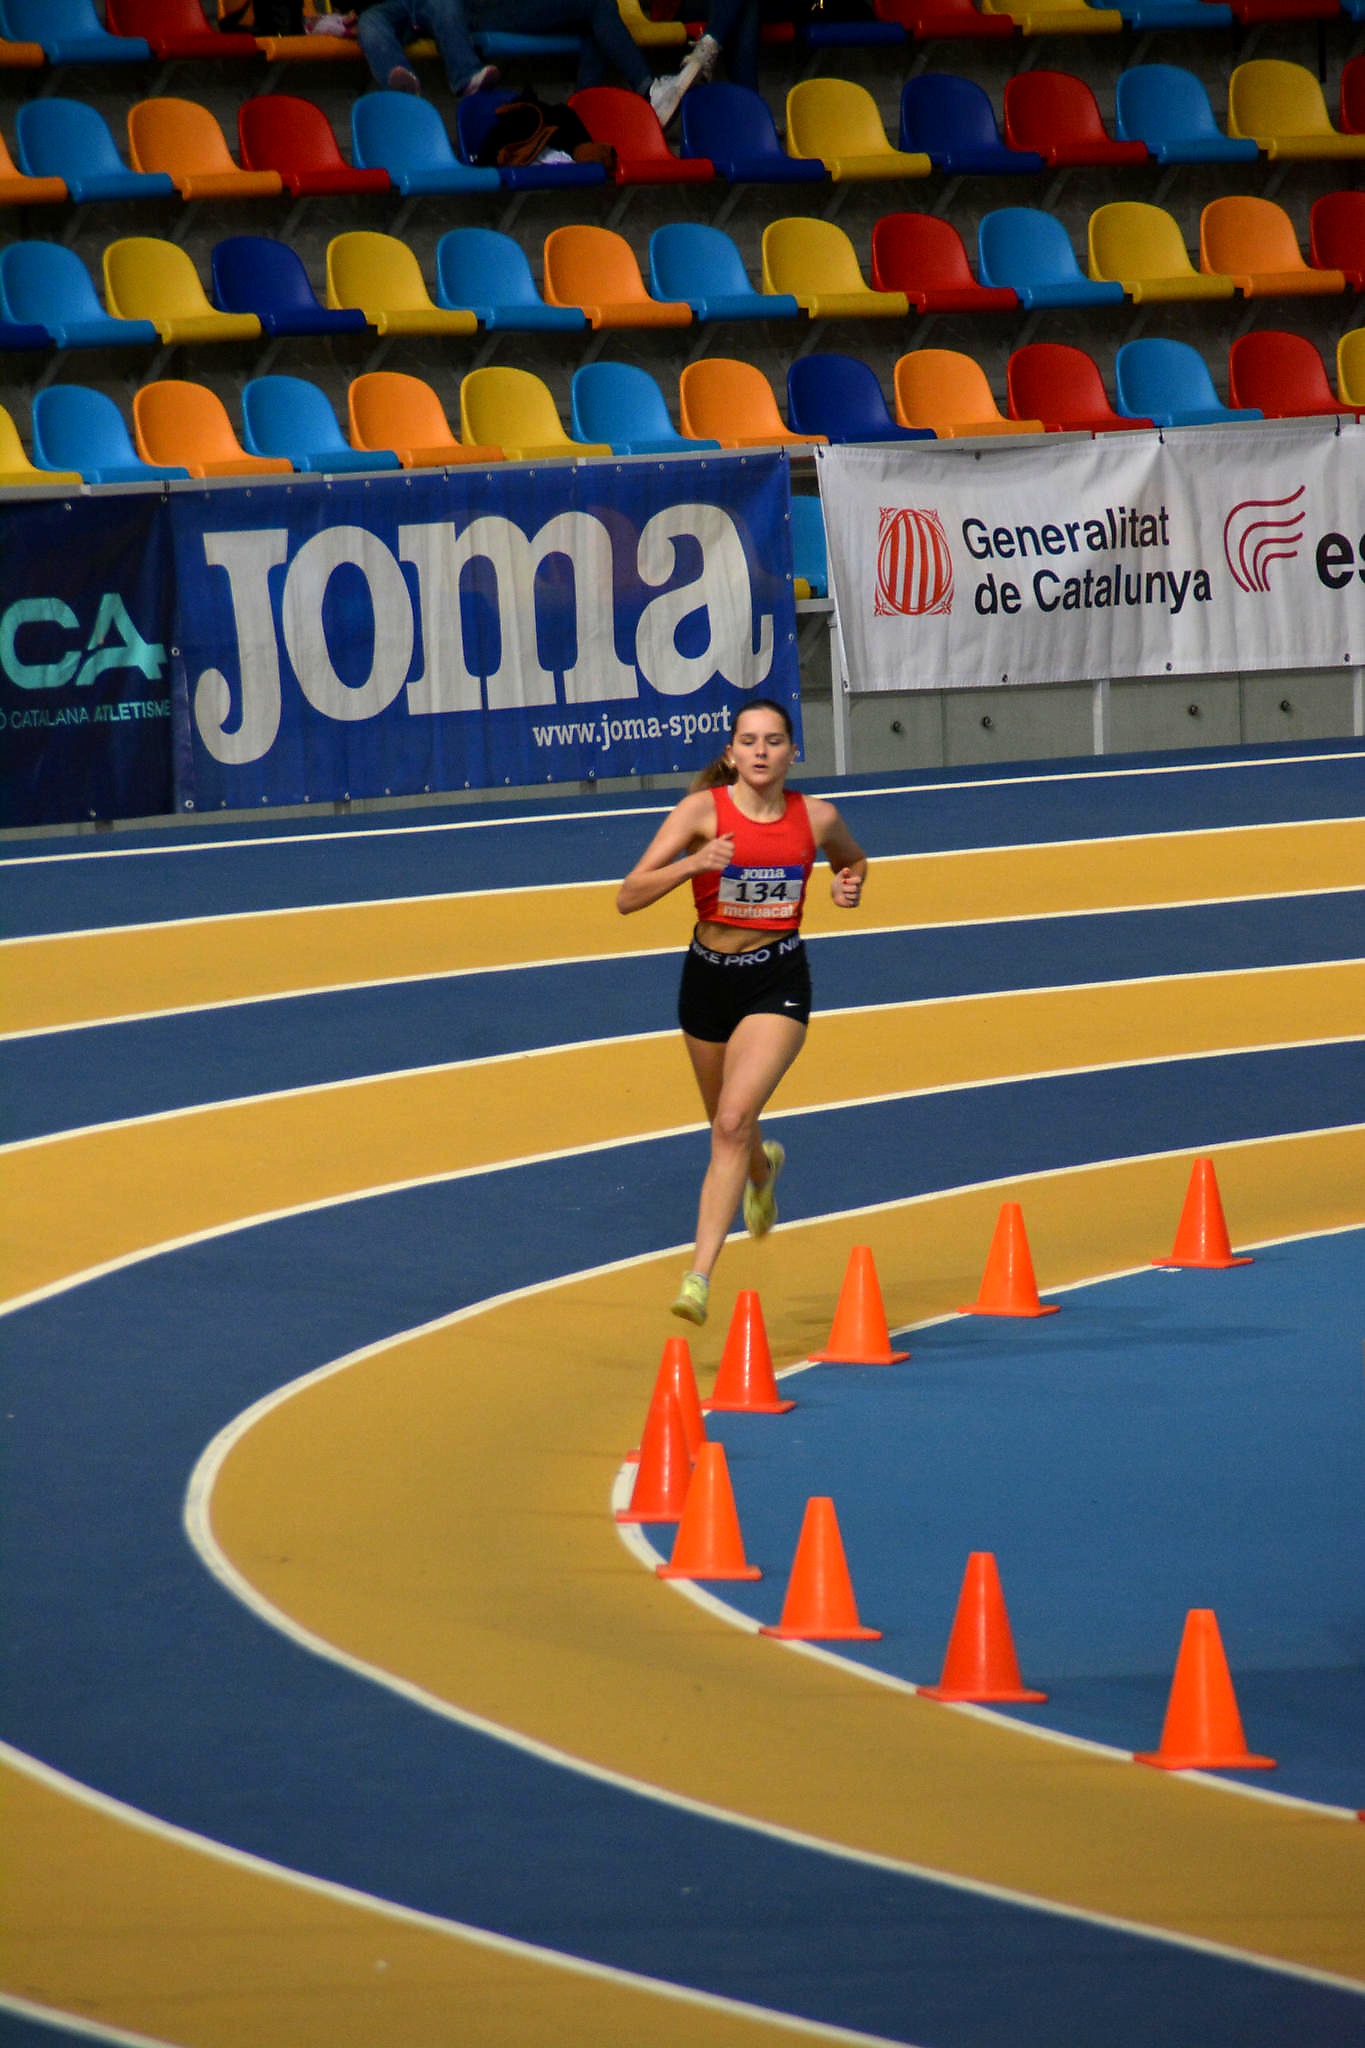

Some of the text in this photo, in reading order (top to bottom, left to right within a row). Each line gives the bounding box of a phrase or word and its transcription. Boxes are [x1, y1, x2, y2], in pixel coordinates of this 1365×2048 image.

[961, 505, 1170, 560] Generalitat
[974, 564, 1213, 616] de Catalunya
[10, 706, 89, 729] CATALANA
[94, 700, 171, 722] ATLETISME
[735, 882, 787, 903] 134
[724, 949, 770, 966] PRO
